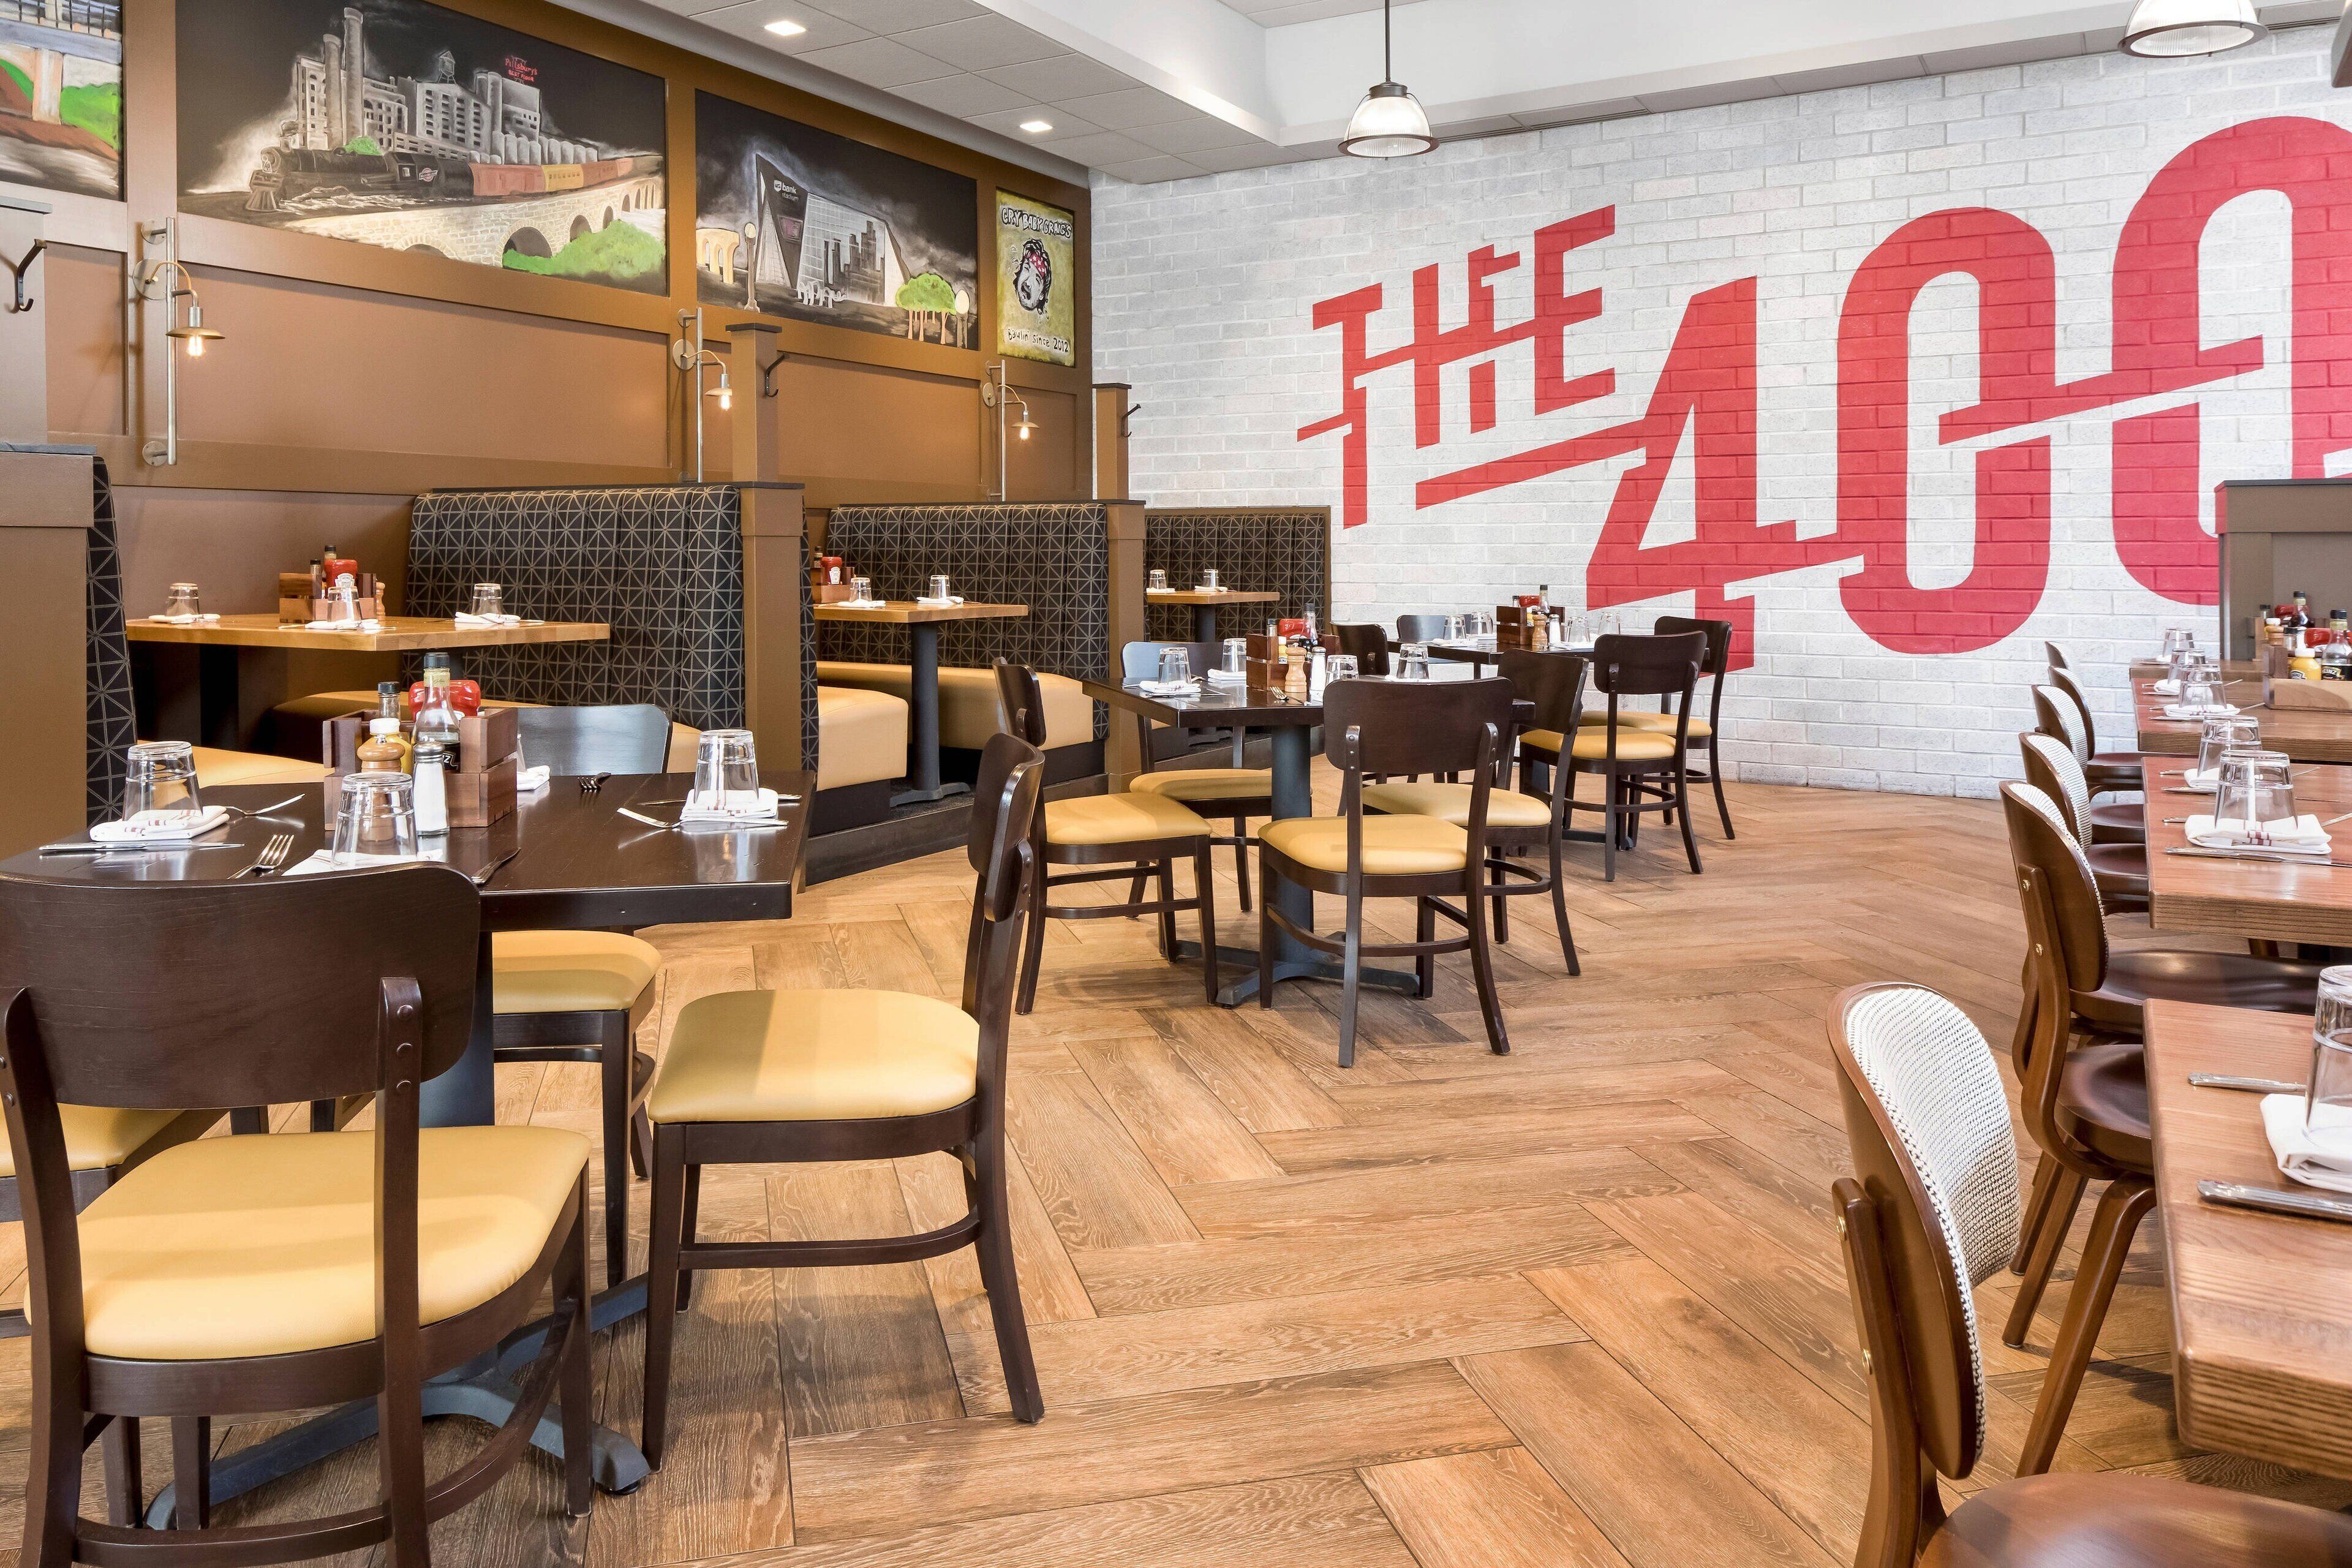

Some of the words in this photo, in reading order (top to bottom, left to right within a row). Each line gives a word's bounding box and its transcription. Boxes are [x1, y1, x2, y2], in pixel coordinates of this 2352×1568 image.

[782, 183, 797, 194] bank
[1001, 208, 1022, 227] CRY
[1022, 213, 1043, 232] BABY
[1033, 334, 1050, 348] since
[1054, 337, 1068, 353] 2012
[1297, 205, 1615, 529] THE
[1416, 116, 2352, 673] 400
